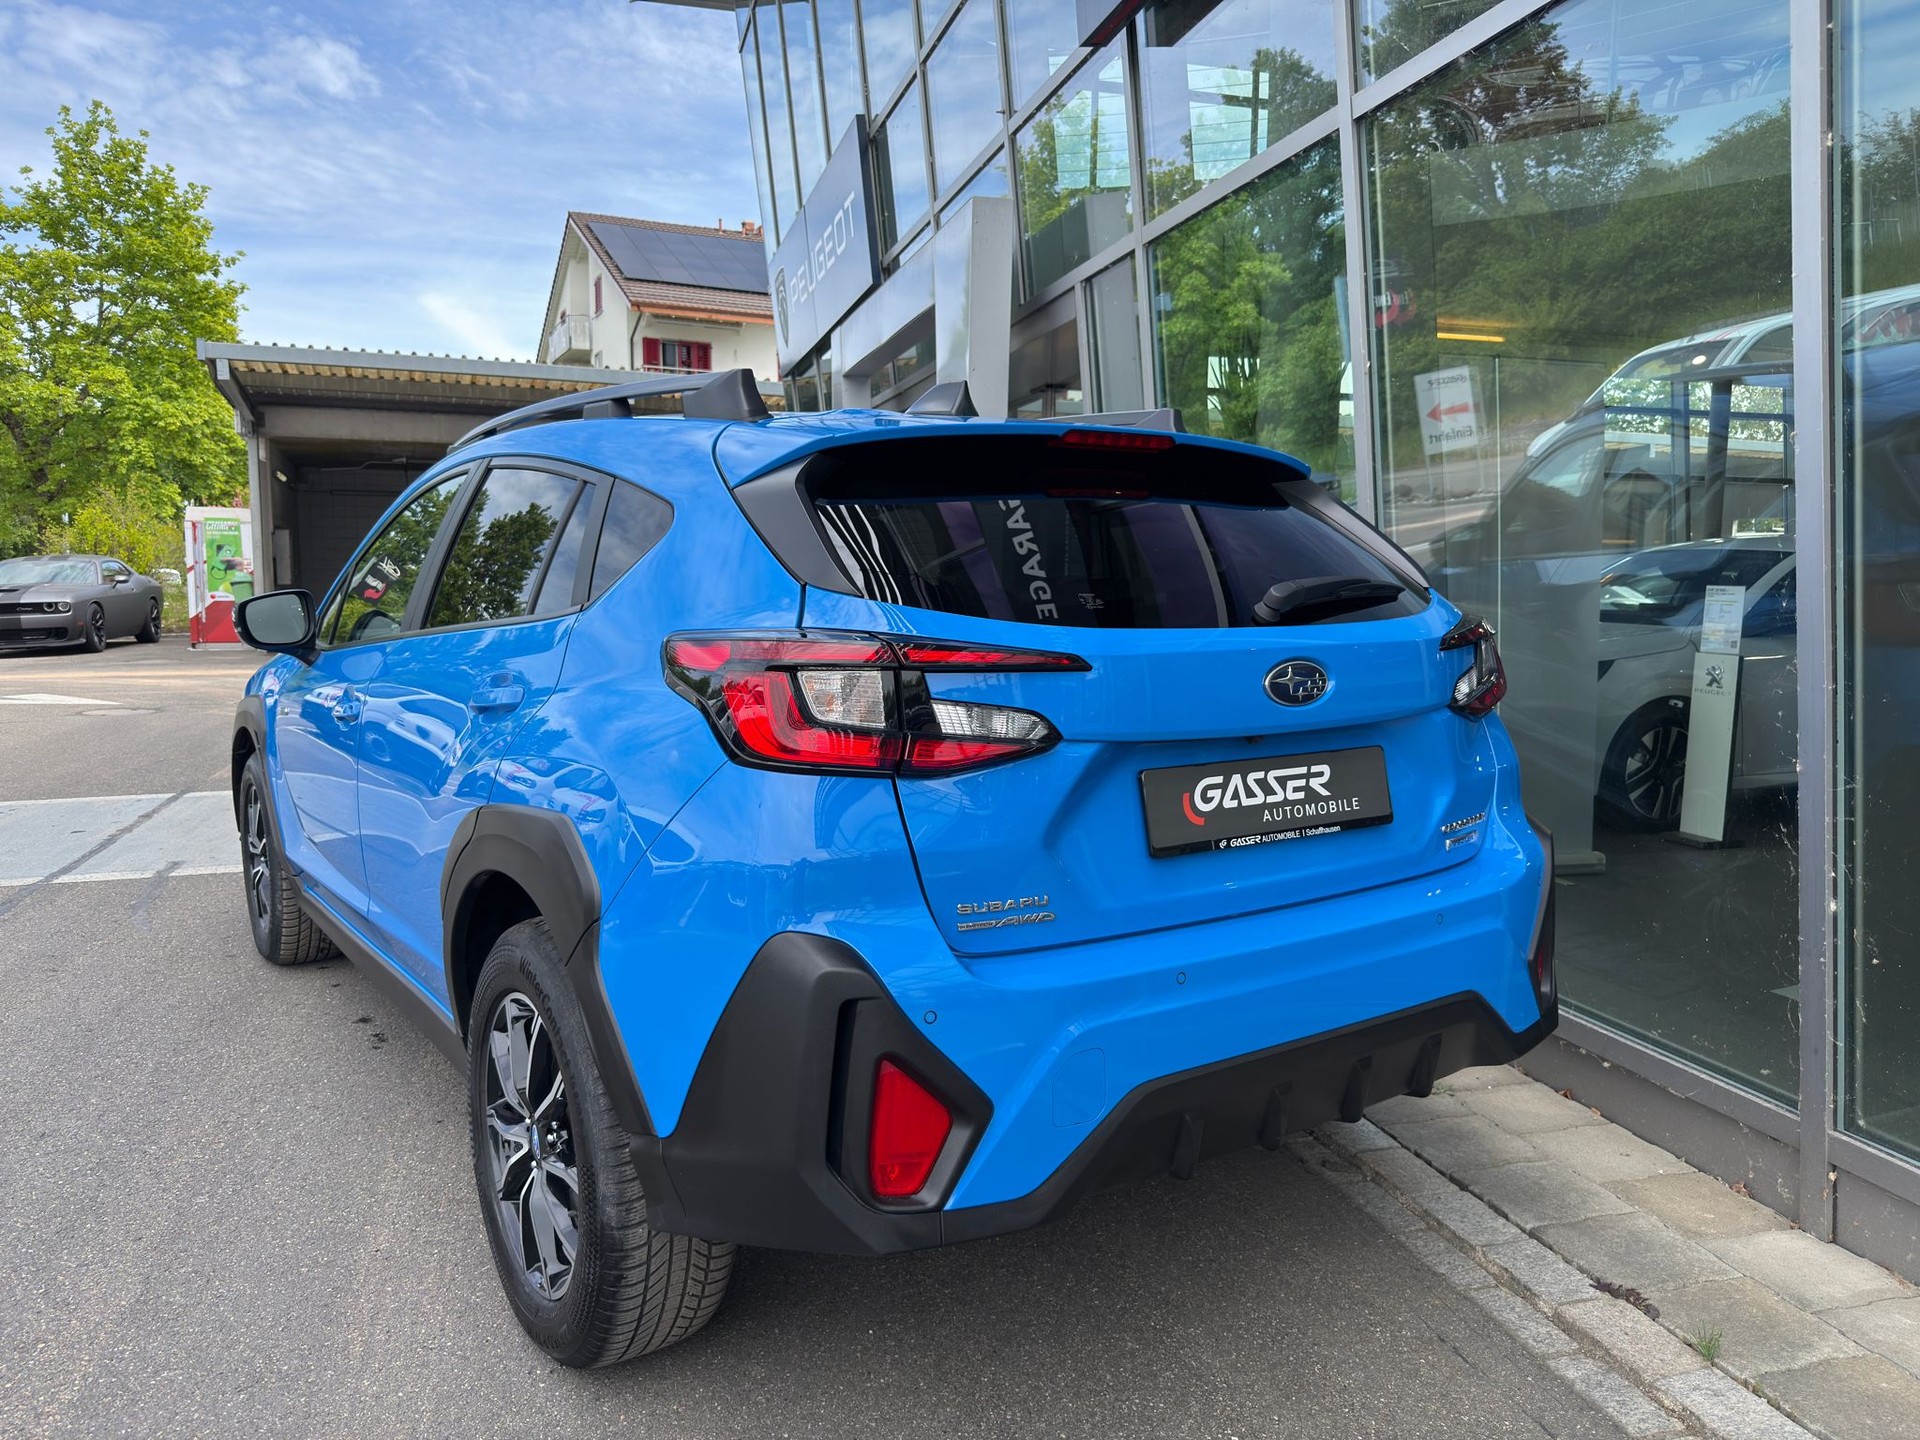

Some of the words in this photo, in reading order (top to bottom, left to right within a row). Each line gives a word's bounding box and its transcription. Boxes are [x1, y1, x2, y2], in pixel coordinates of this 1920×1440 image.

[790, 190, 856, 312] PEUGEOT
[1193, 764, 1331, 812] GASSER
[1263, 797, 1361, 822] AUTOMOBILE
[1230, 835, 1262, 848] GASSER
[1262, 829, 1301, 843] AUTOMOBILE
[1306, 825, 1341, 836] Schaffhausen
[956, 894, 1050, 916] SUBARU
